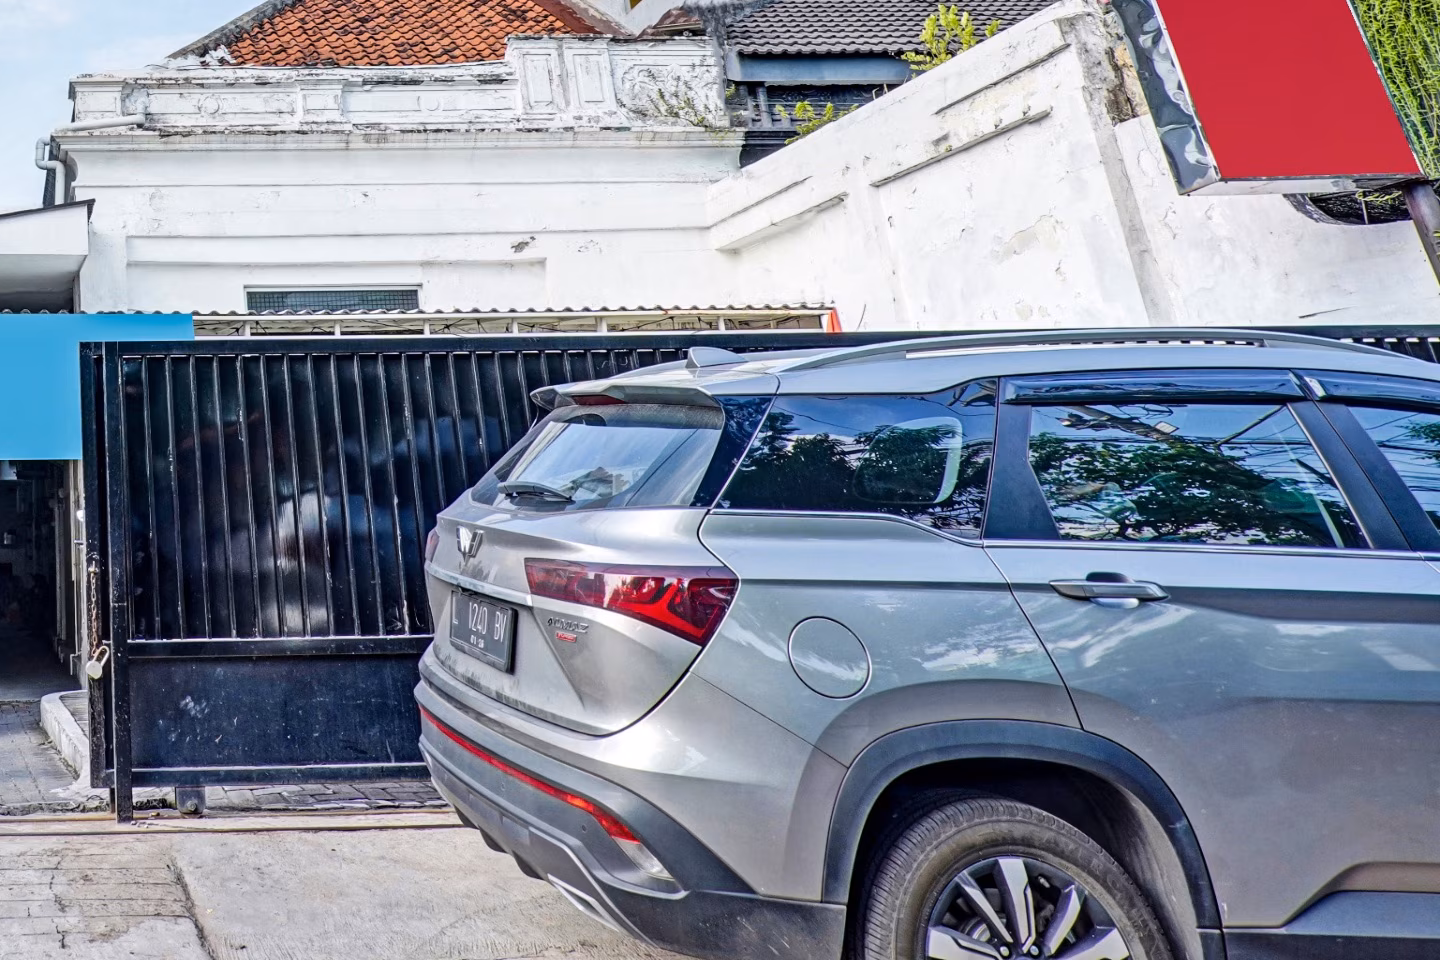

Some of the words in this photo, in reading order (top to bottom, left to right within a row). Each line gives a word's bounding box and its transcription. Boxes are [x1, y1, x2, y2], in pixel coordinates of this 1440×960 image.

[452, 596, 459, 625] L
[468, 601, 489, 635] 1240
[493, 611, 507, 643] BV
